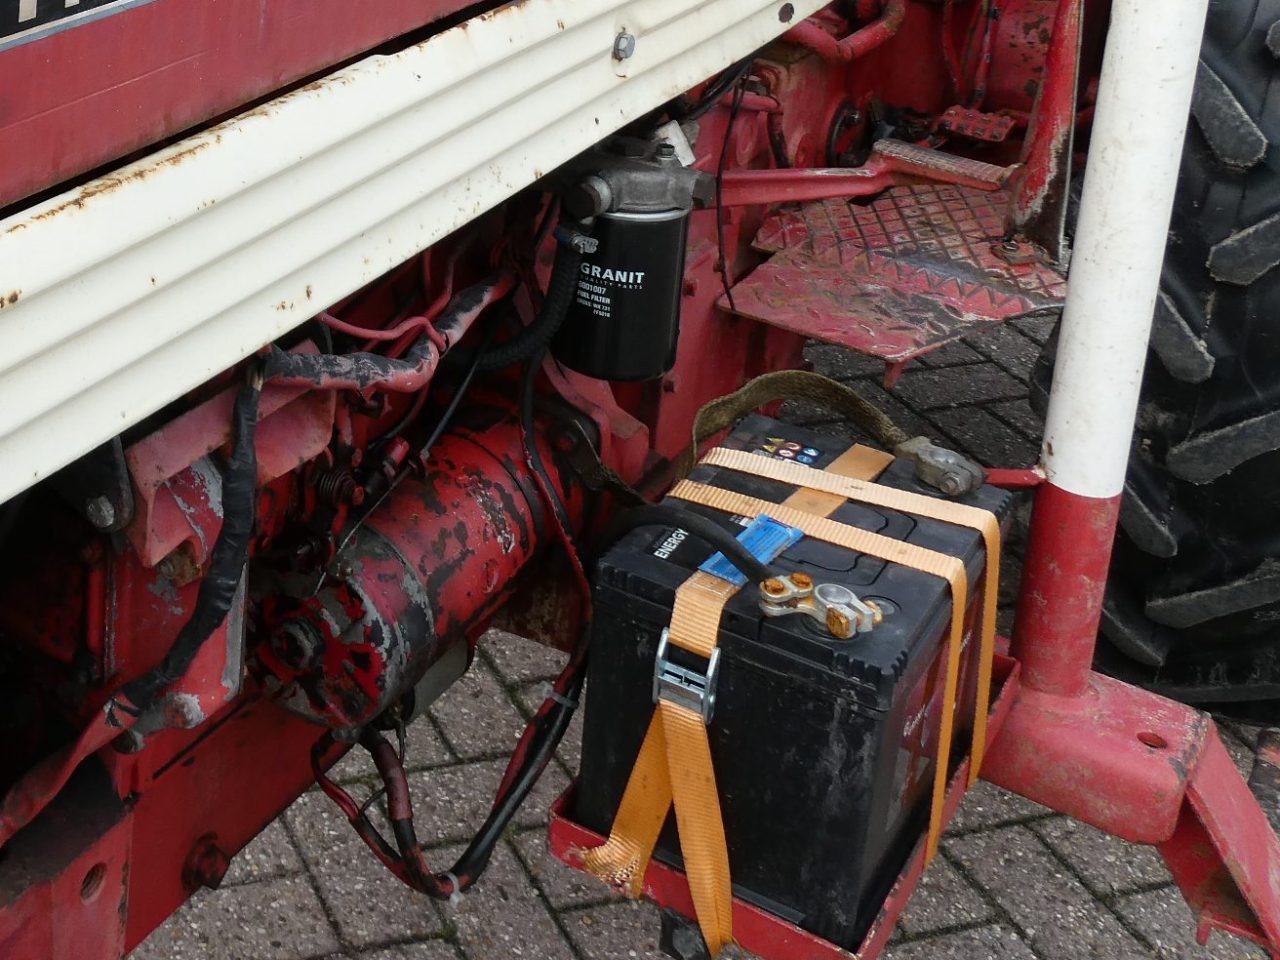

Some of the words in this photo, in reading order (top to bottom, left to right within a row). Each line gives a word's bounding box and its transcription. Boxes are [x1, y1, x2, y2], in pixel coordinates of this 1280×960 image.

[580, 262, 645, 283] GRANIT
[590, 294, 610, 304] FILTER
[653, 527, 689, 560] ENERGY
